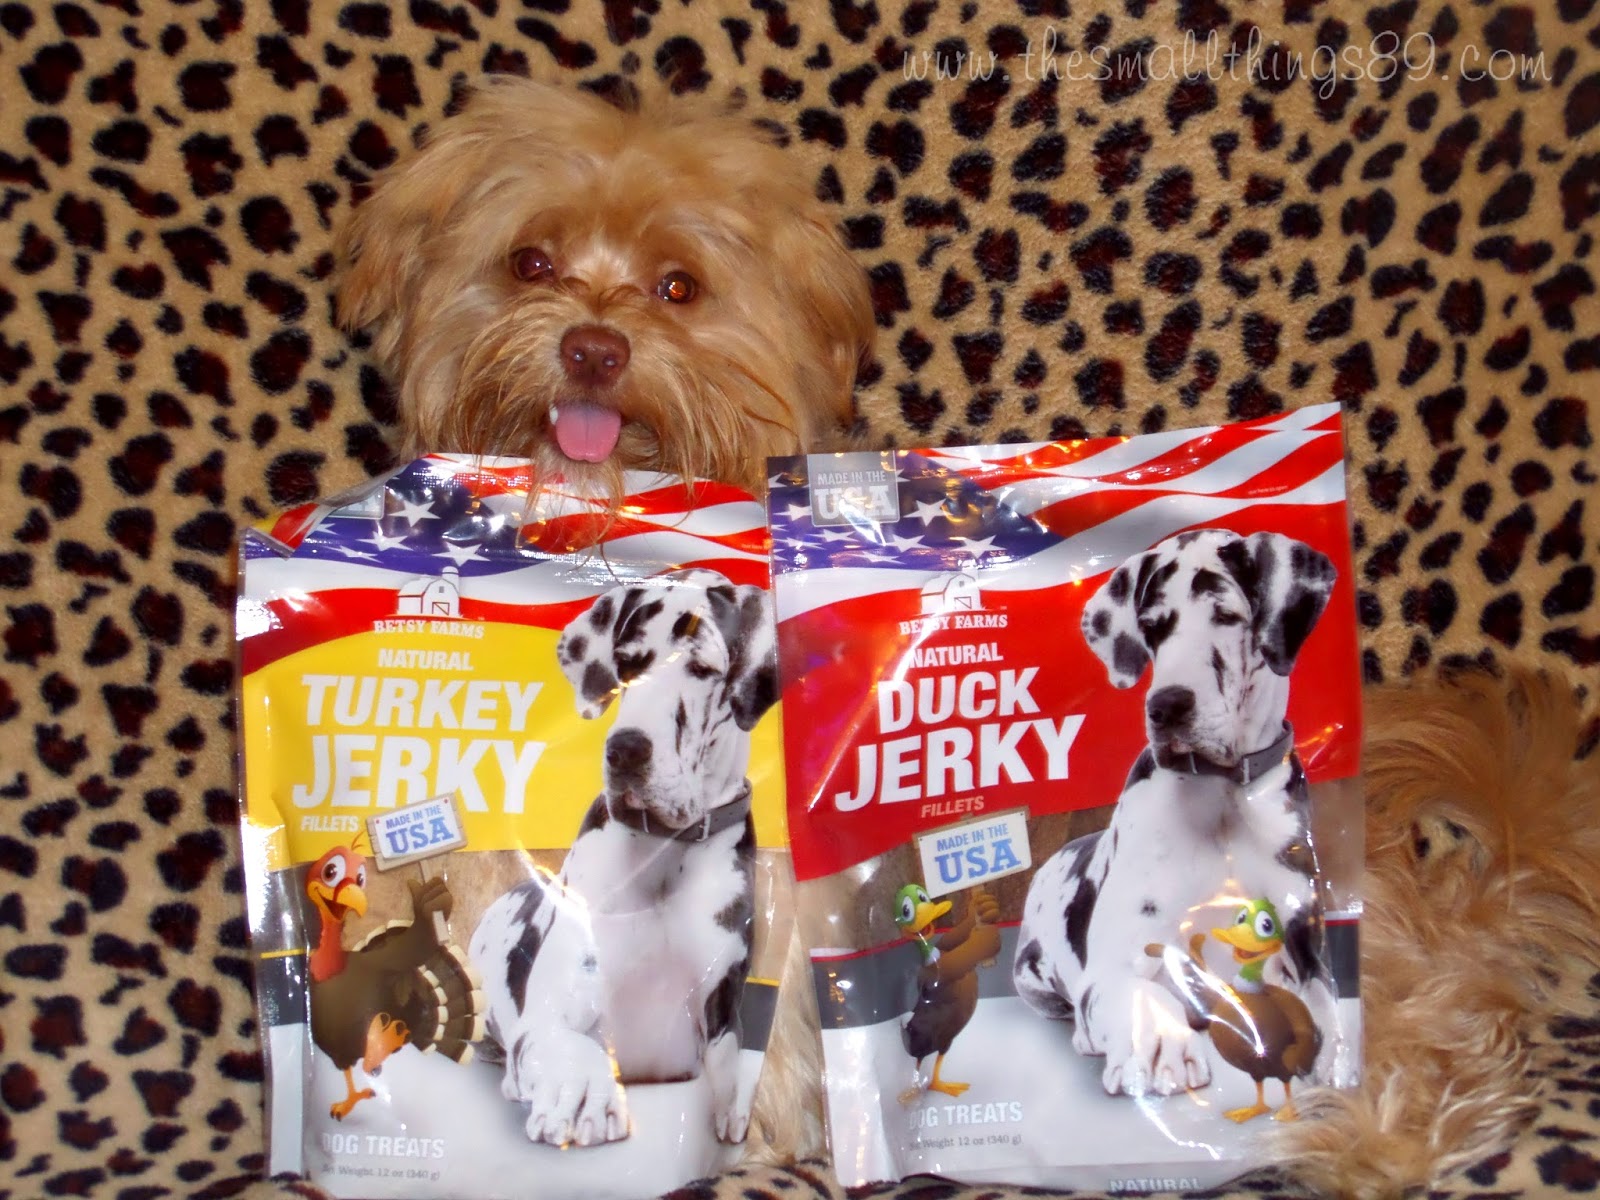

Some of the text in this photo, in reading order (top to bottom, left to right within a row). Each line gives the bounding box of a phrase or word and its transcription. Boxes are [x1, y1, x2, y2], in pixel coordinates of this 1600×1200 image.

[817, 470, 886, 485] MADE IN THE
[373, 619, 485, 639] BETSY FARMS
[955, 614, 1008, 629] FARMS
[378, 648, 474, 671] NATURAL
[909, 642, 1004, 669] NATURAL
[301, 673, 544, 732] TURKEY
[877, 666, 1041, 734] DUCK
[292, 733, 548, 814] JERKY
[834, 713, 1087, 812] JERKY
[385, 805, 442, 829] MADE IN THE
[921, 795, 985, 818] FILLETS
[300, 815, 360, 832] FILLETS
[385, 816, 454, 854] USA
[936, 823, 1009, 852] MADE IN THE
[934, 838, 1021, 884] USA
[944, 1101, 1023, 1125] TREATS
[322, 1133, 444, 1158] DOG TREATS
[958, 1136, 971, 1147] 12
[972, 1137, 985, 1146] oz
[378, 1167, 390, 1177] 12
[1110, 1178, 1202, 1192] NATURAL
